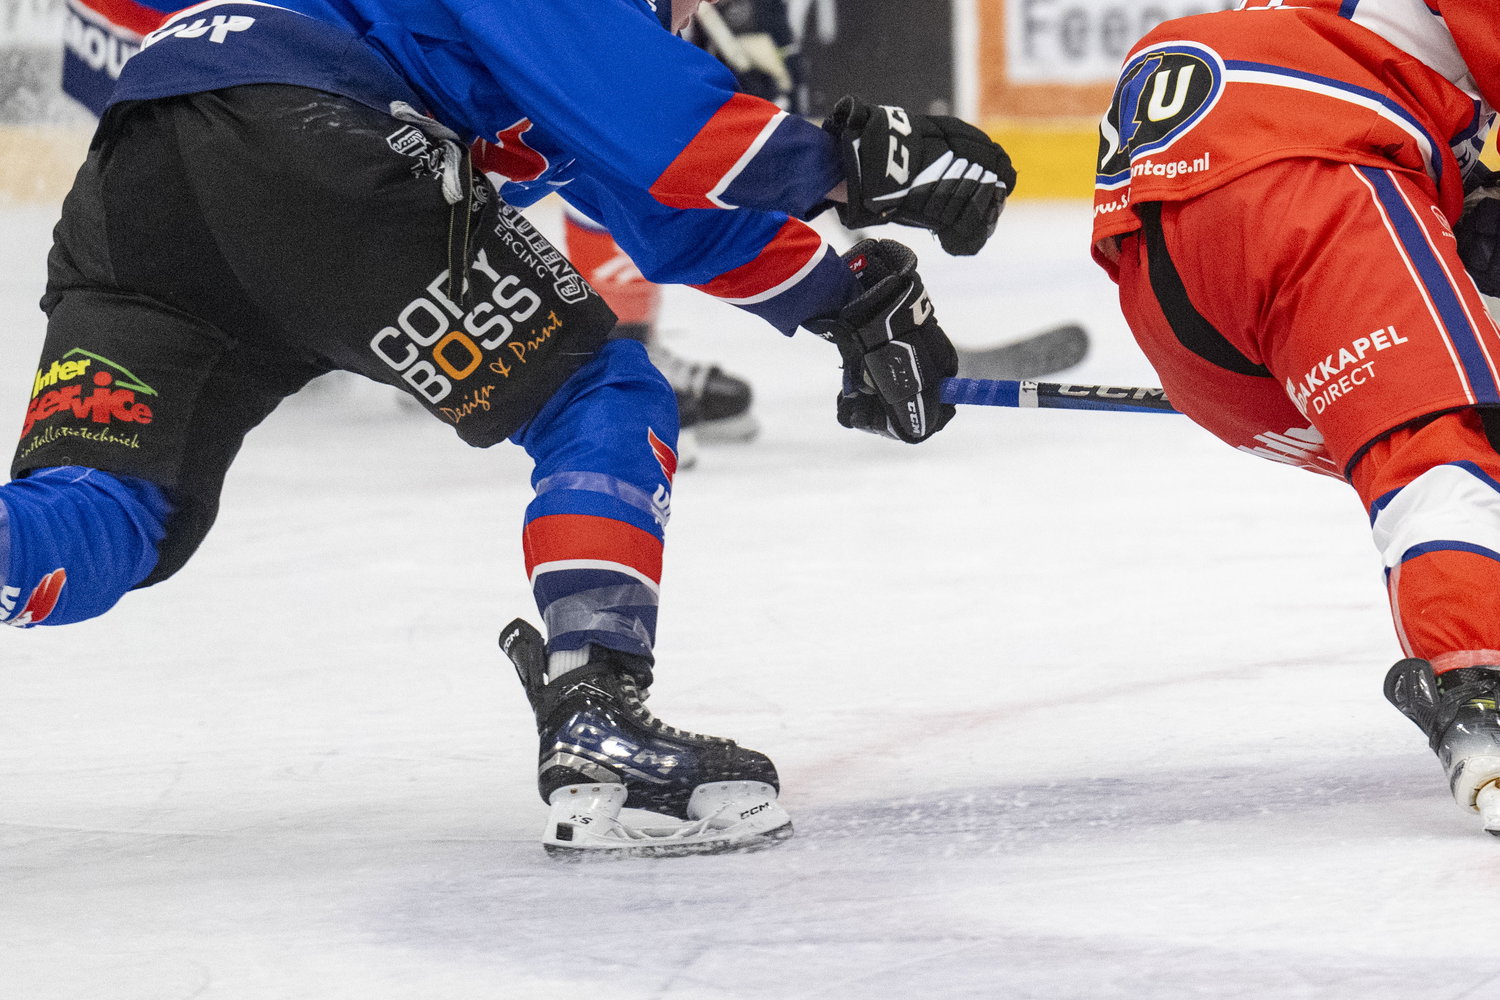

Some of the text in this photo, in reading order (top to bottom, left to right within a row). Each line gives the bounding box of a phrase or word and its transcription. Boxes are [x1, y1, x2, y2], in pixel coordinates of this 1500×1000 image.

[885, 104, 912, 185] CC
[494, 224, 549, 279] ERCING
[370, 248, 502, 372] COPY
[401, 274, 542, 405] BOSS
[31, 359, 91, 400] Inter
[440, 383, 496, 424] Design
[508, 310, 564, 364] Print
[1057, 383, 1169, 401] CCM
[1312, 361, 1378, 415] DIRECT
[907, 401, 921, 435] CCM
[740, 801, 769, 820] CCM
